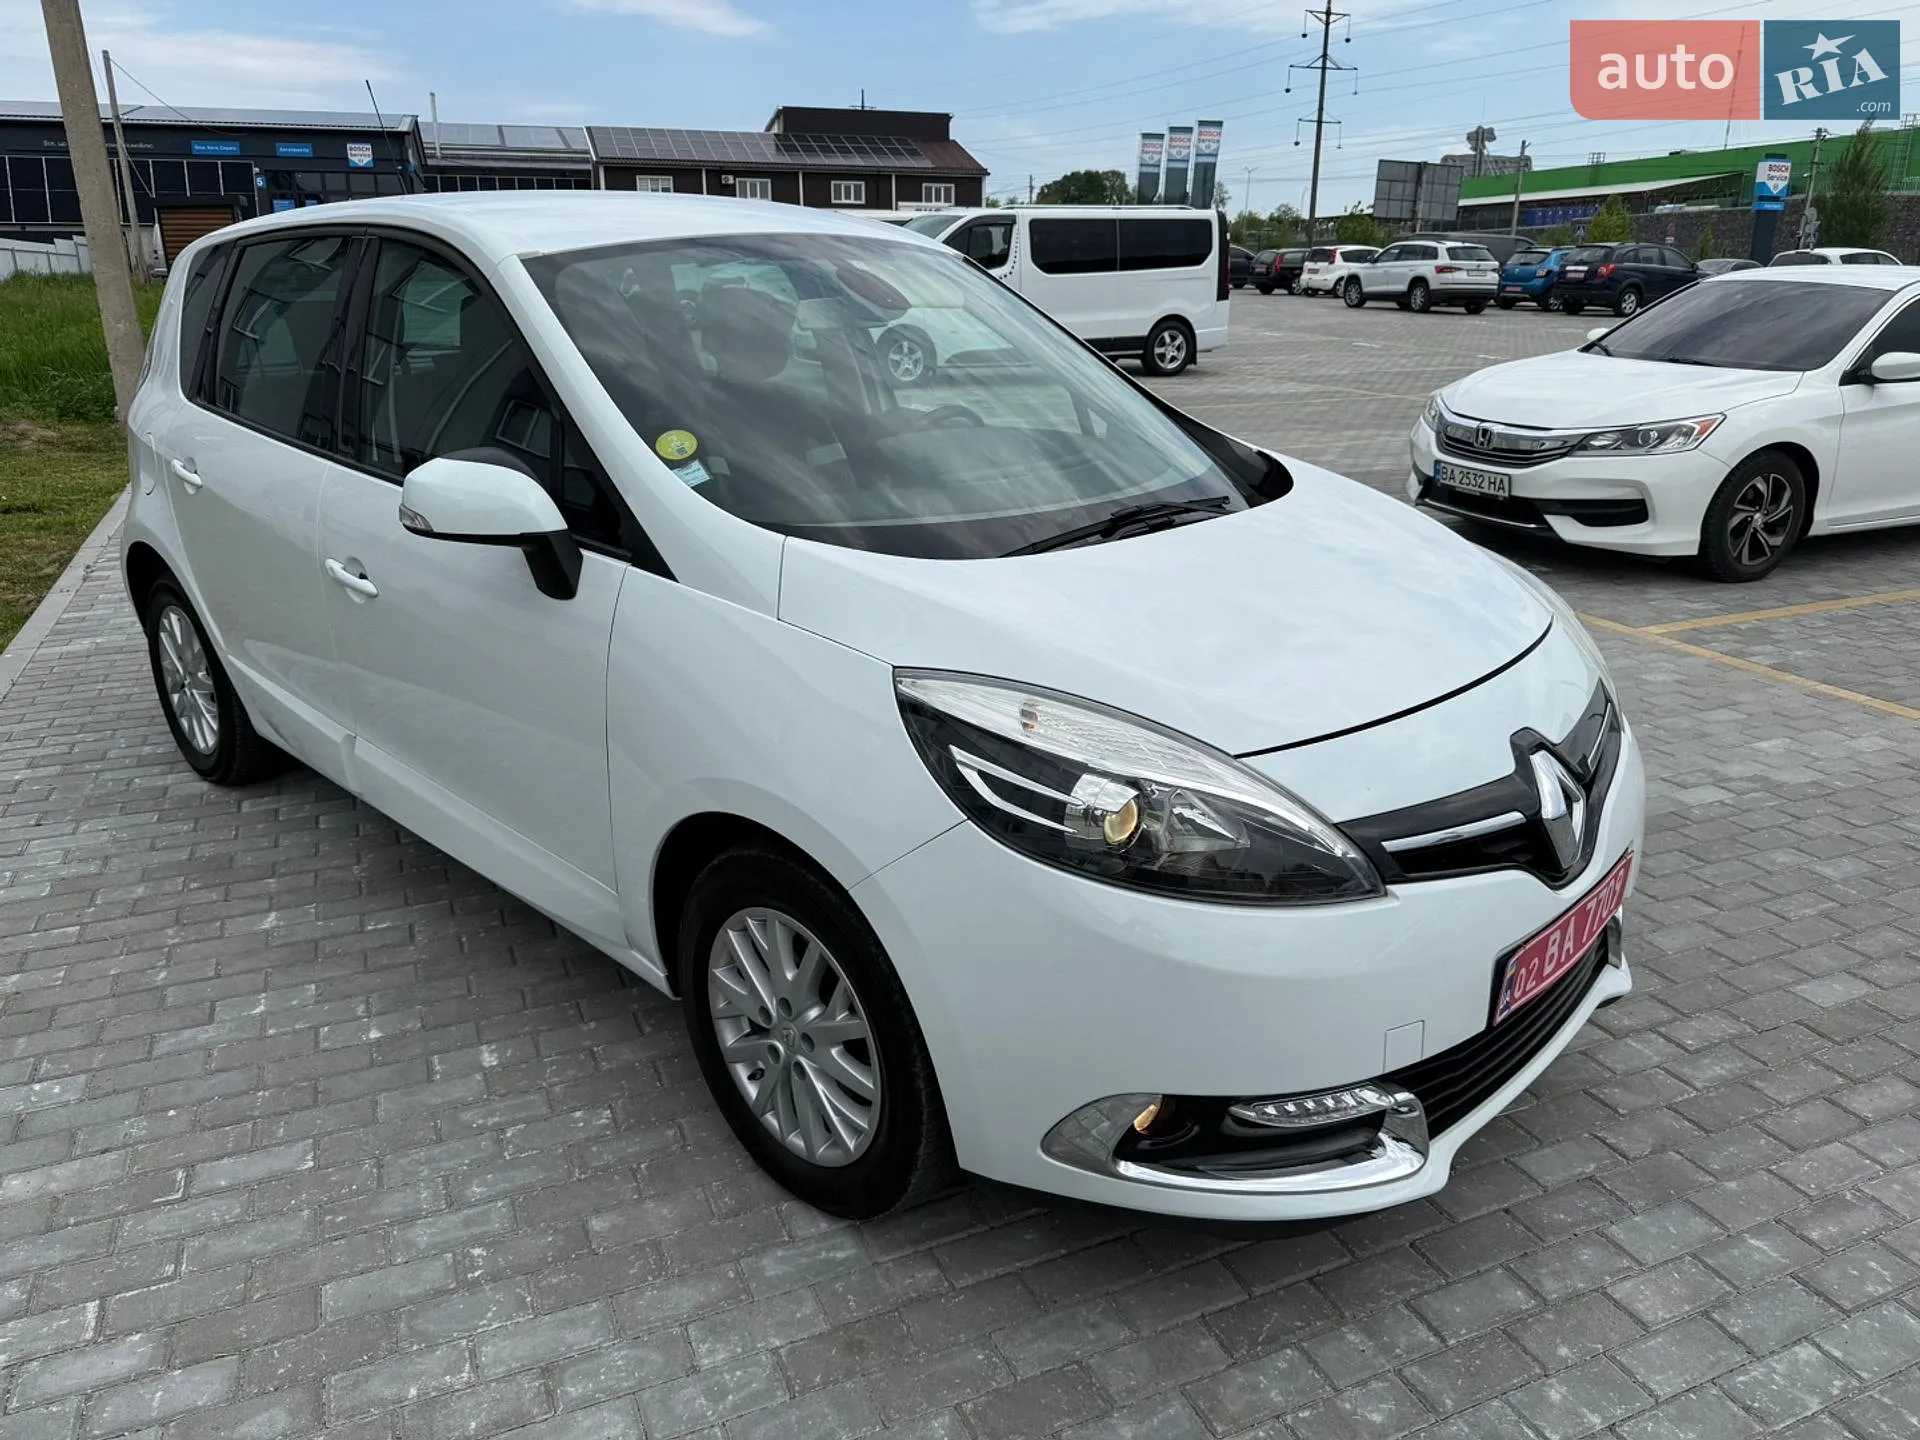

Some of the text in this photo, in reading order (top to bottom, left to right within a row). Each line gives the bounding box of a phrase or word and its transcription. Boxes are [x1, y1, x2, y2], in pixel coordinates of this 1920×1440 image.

[1768, 164, 1789, 173] BOSCH
[256, 177, 263, 187] 5
[1766, 173, 1788, 182] Service
[1441, 466, 1506, 494] BA 2532 HA
[1514, 957, 1539, 999] 02
[1543, 916, 1575, 977] BA
